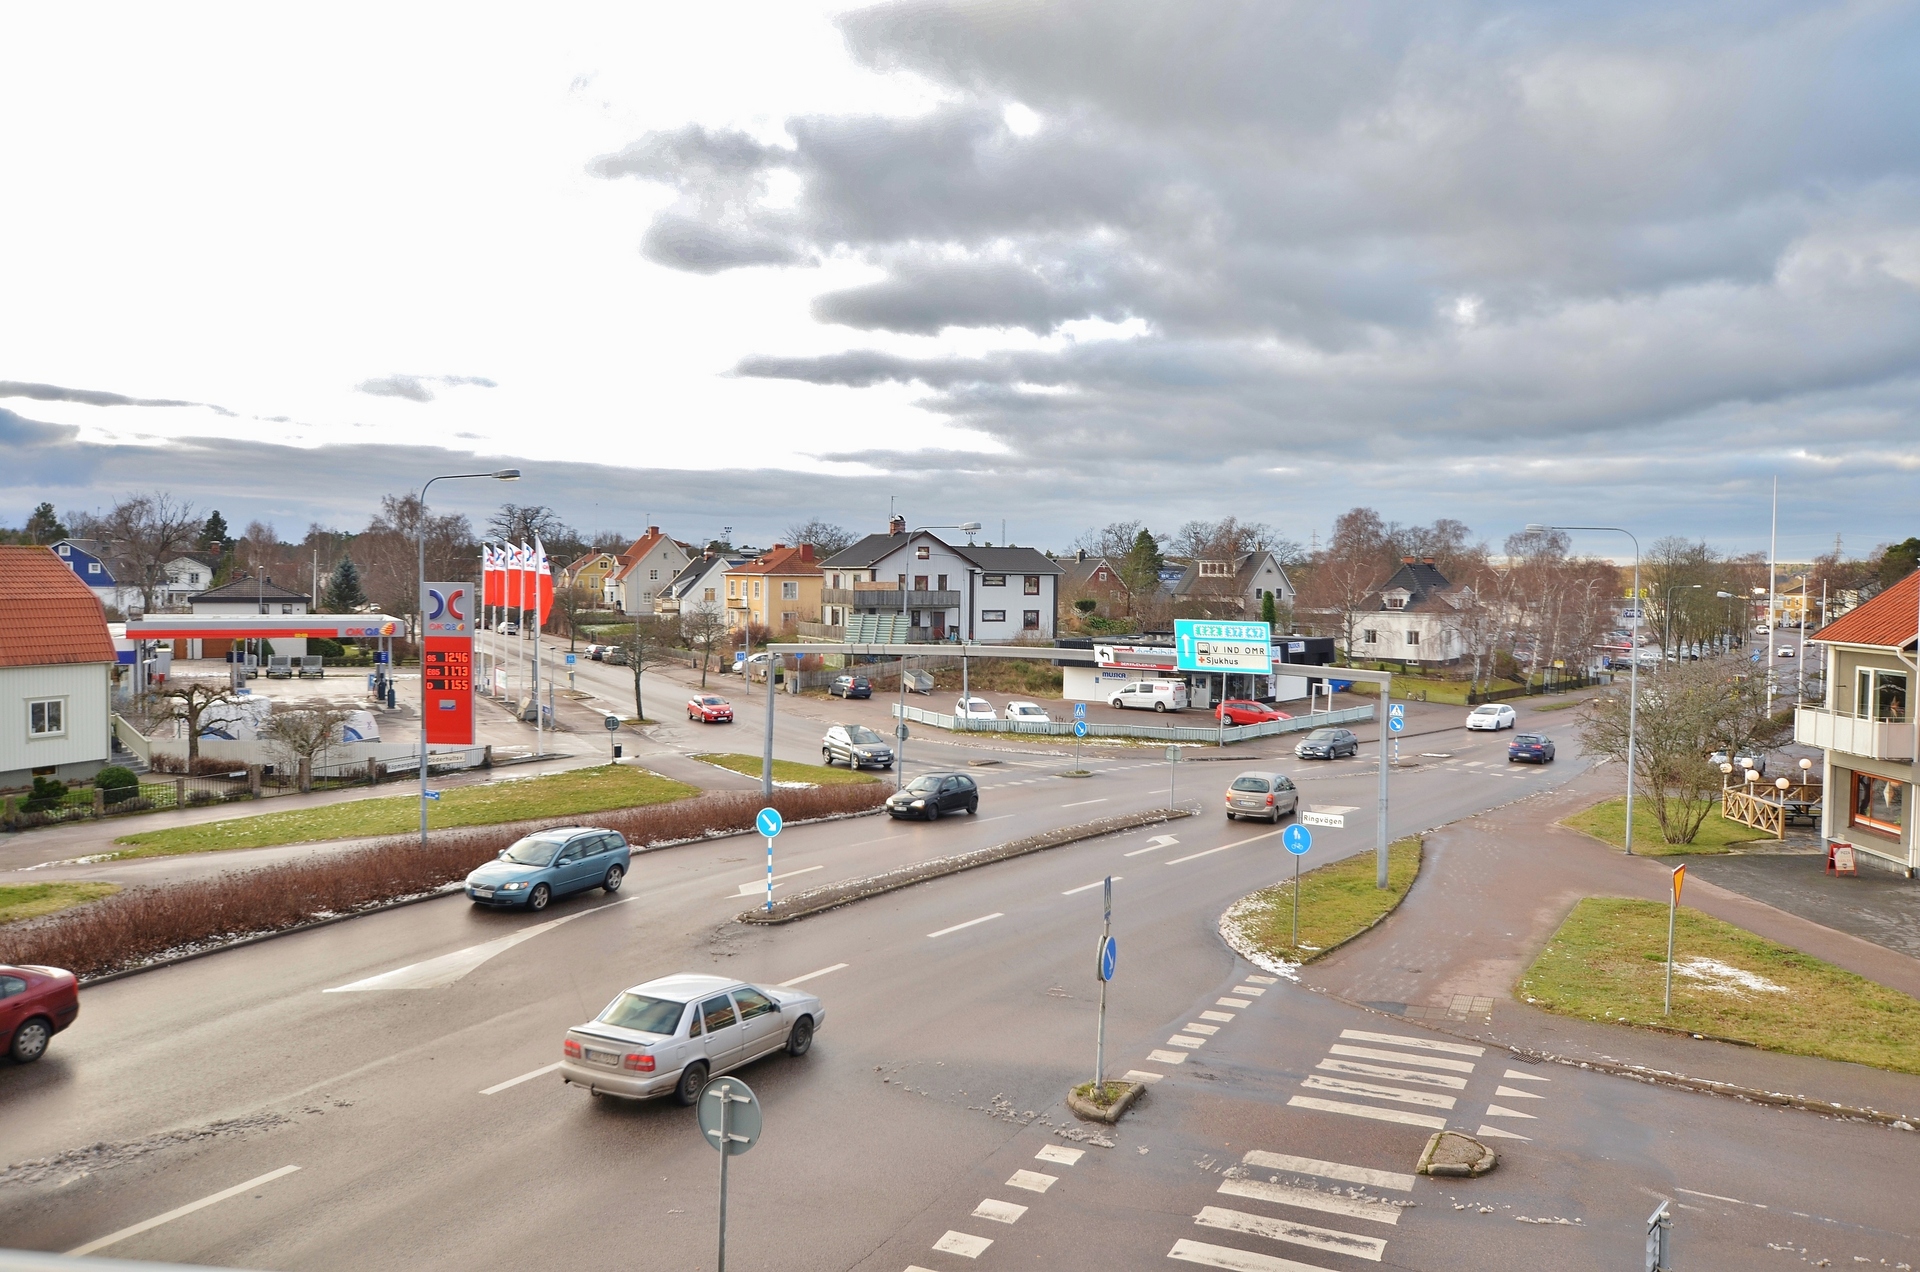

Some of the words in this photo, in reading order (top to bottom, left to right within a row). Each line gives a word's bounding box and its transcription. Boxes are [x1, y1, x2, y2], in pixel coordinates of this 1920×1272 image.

[1199, 627, 1219, 635] E22
[1228, 628, 1241, 636] 37
[1247, 629, 1261, 637] 47
[1223, 646, 1240, 654] IND
[1244, 647, 1265, 655] OMR
[1206, 657, 1239, 665] Sjukhus
[427, 668, 441, 676] E85
[1303, 815, 1342, 825] Ringvägen
